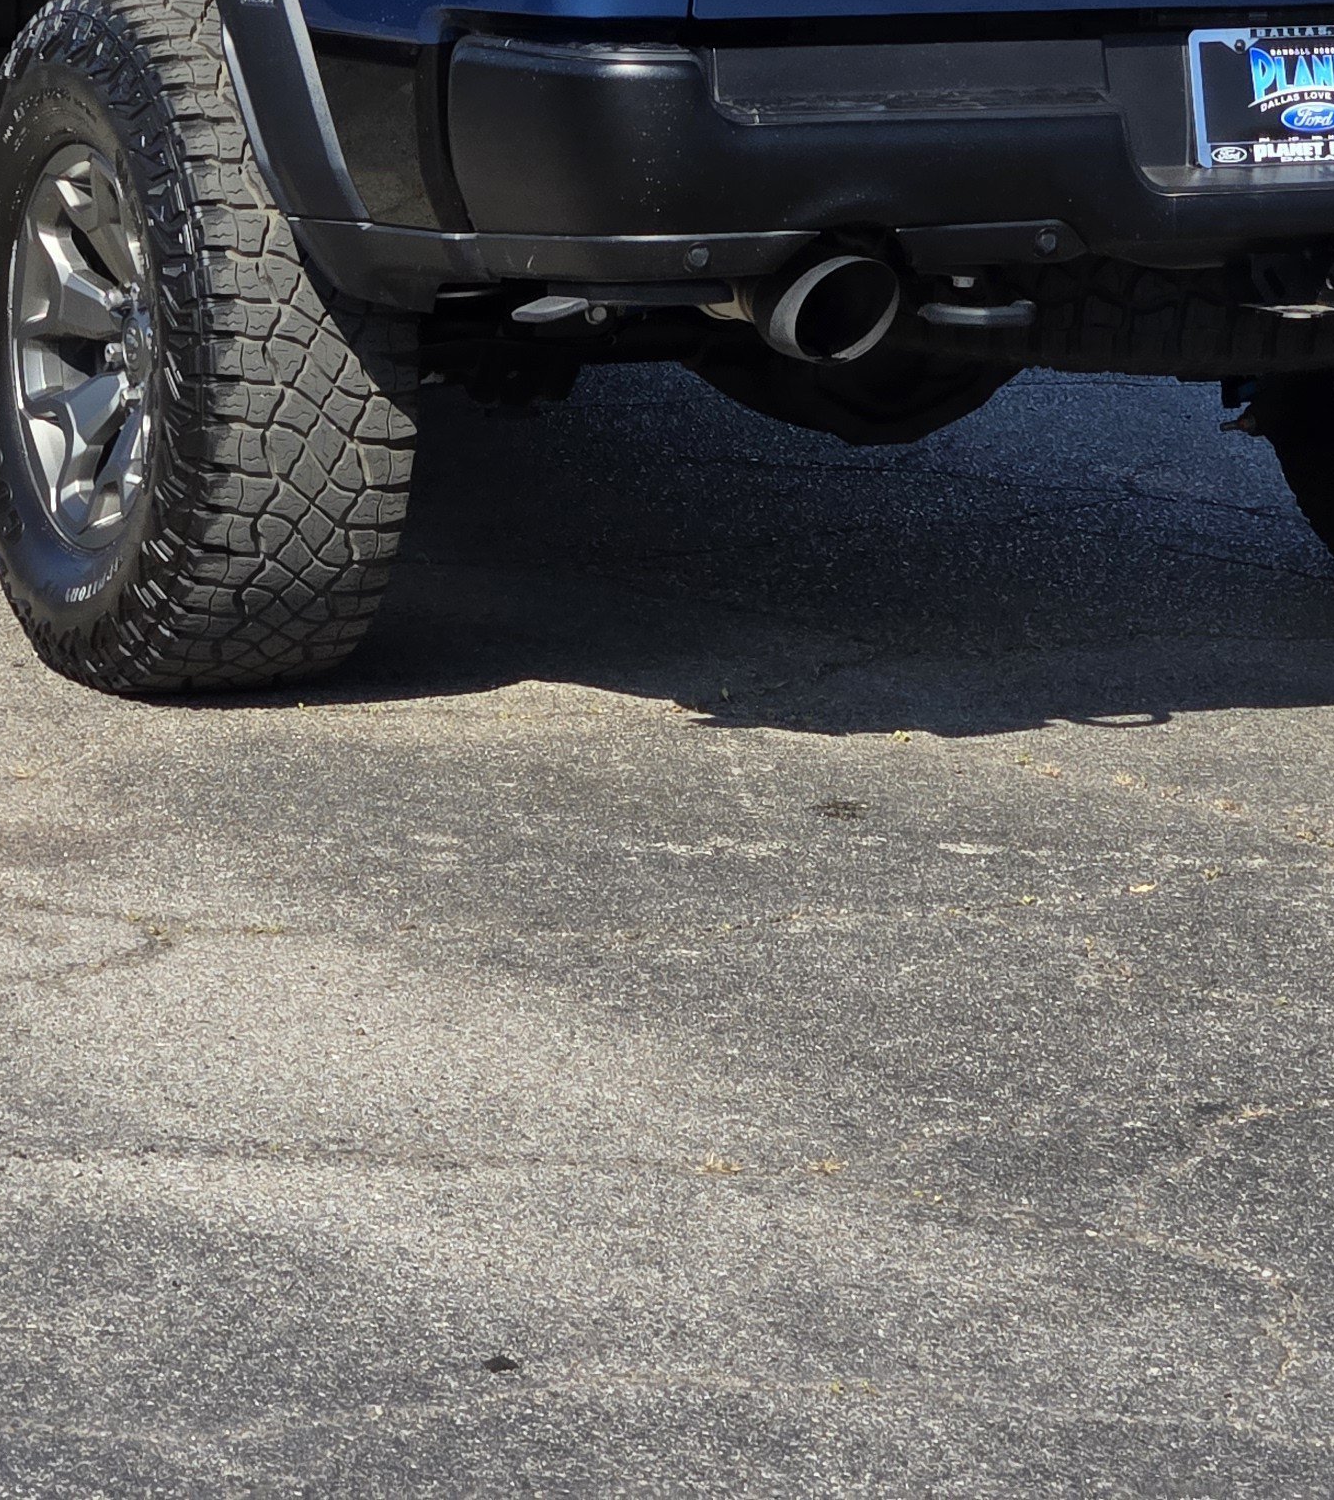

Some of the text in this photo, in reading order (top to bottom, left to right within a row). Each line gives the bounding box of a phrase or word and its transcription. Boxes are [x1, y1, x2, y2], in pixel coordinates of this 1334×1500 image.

[1260, 92, 1300, 112] DALLAS
[1303, 91, 1332, 100] LOVE
[1293, 106, 1334, 127] Ford
[1253, 141, 1325, 162] PLANET
